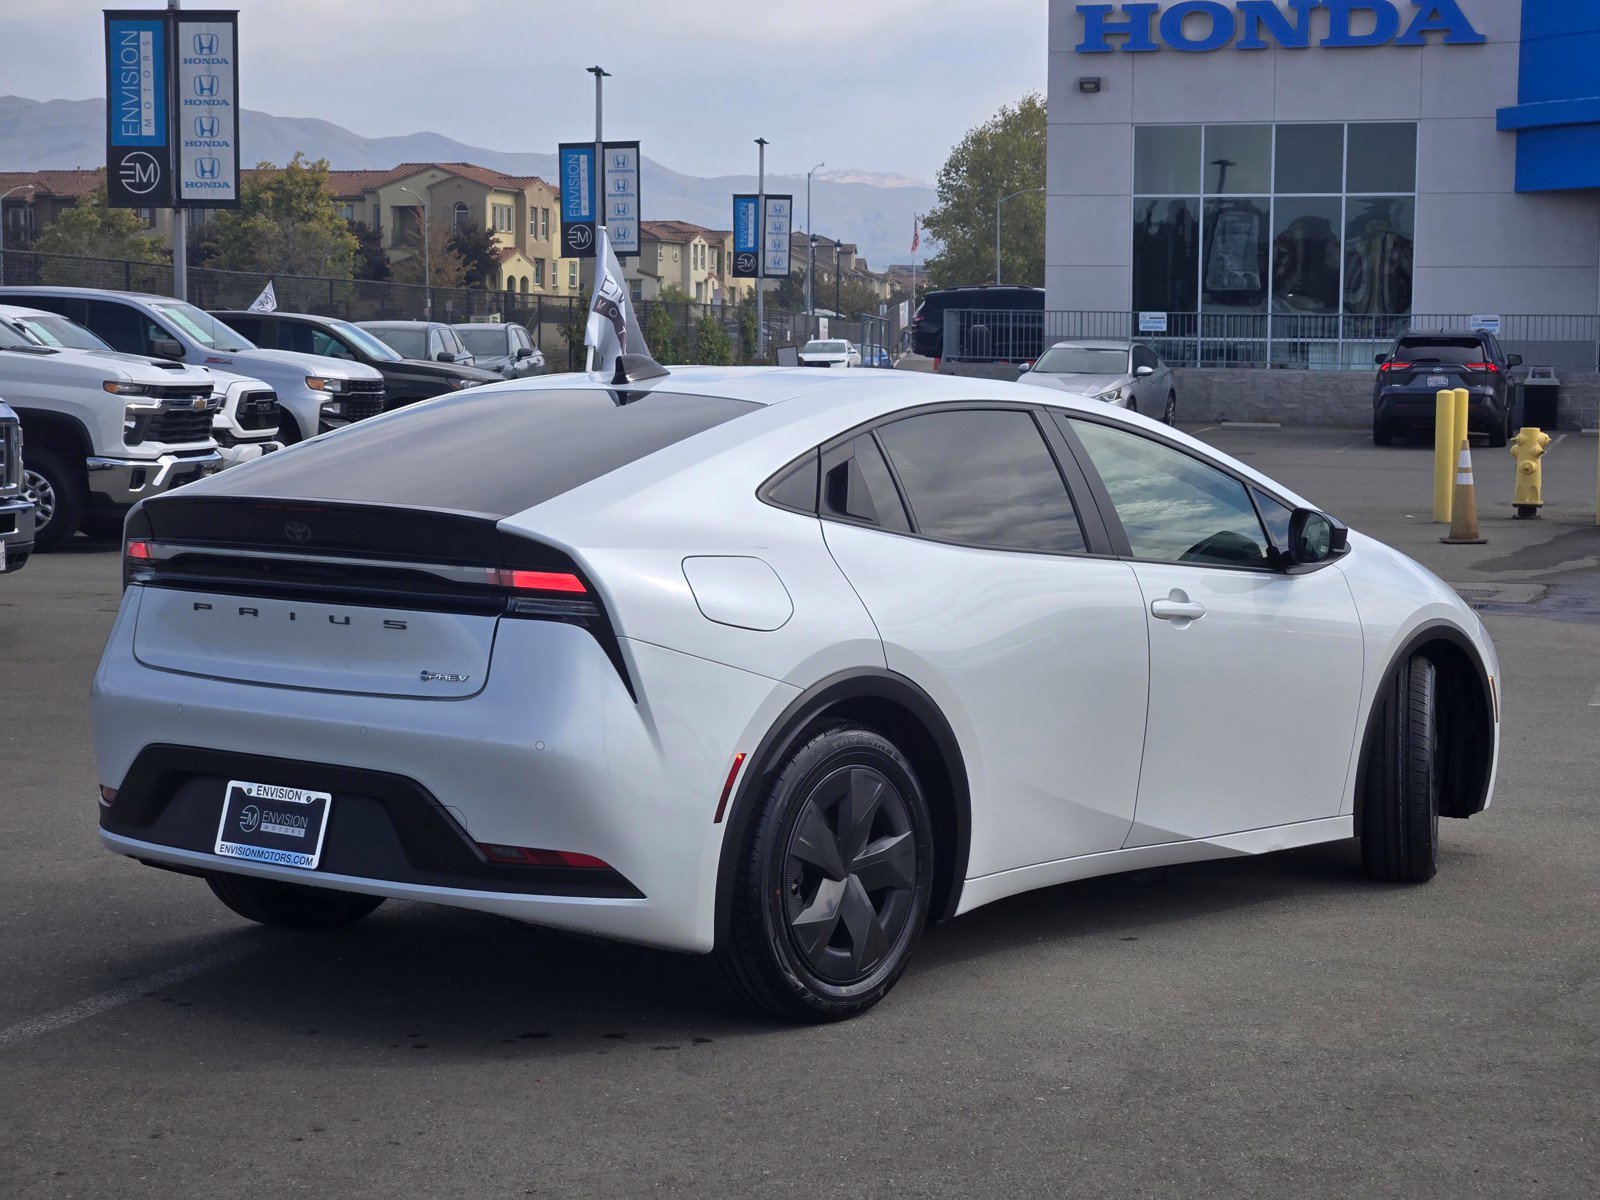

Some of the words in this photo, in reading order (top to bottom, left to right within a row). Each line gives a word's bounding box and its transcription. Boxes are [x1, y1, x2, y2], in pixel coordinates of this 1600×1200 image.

[1074, 0, 1487, 53] HONDA
[121, 30, 140, 137] ENVISION
[144, 40, 152, 127] MOTORS
[185, 181, 231, 189] HONDA
[568, 154, 580, 217] ENVISION
[739, 202, 748, 249] ENVISION
[193, 602, 408, 631] PRIUS
[428, 671, 471, 683] PHEV
[256, 785, 303, 802] ENVISION
[262, 810, 309, 829] ENVISION
[264, 825, 302, 836] MOTORS
[219, 843, 314, 867] ENVISIONMOTORS.COM
